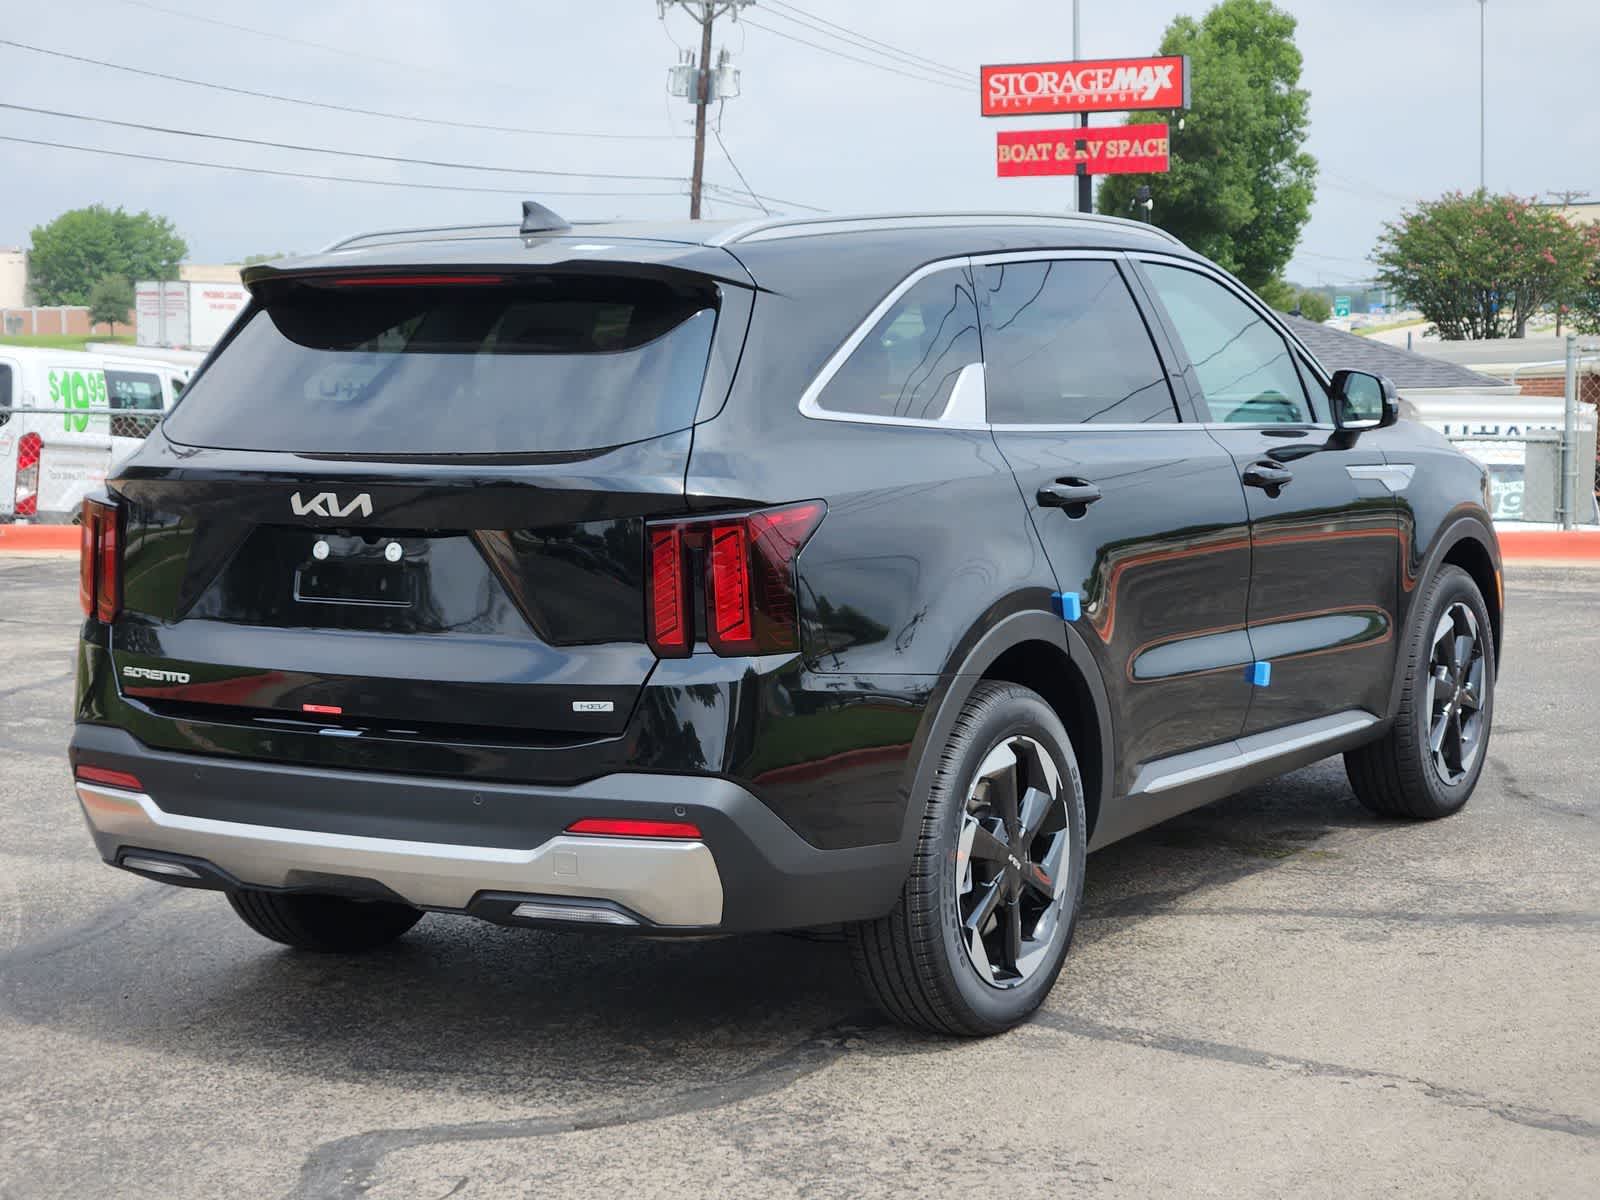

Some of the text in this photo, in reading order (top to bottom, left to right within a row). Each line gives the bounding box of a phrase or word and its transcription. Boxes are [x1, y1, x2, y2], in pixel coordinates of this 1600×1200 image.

[999, 143, 1052, 162] BOAT
[1055, 142, 1069, 160] &
[1106, 137, 1168, 157] SPACE
[290, 491, 374, 518] KIA
[123, 666, 191, 684] SORENTO
